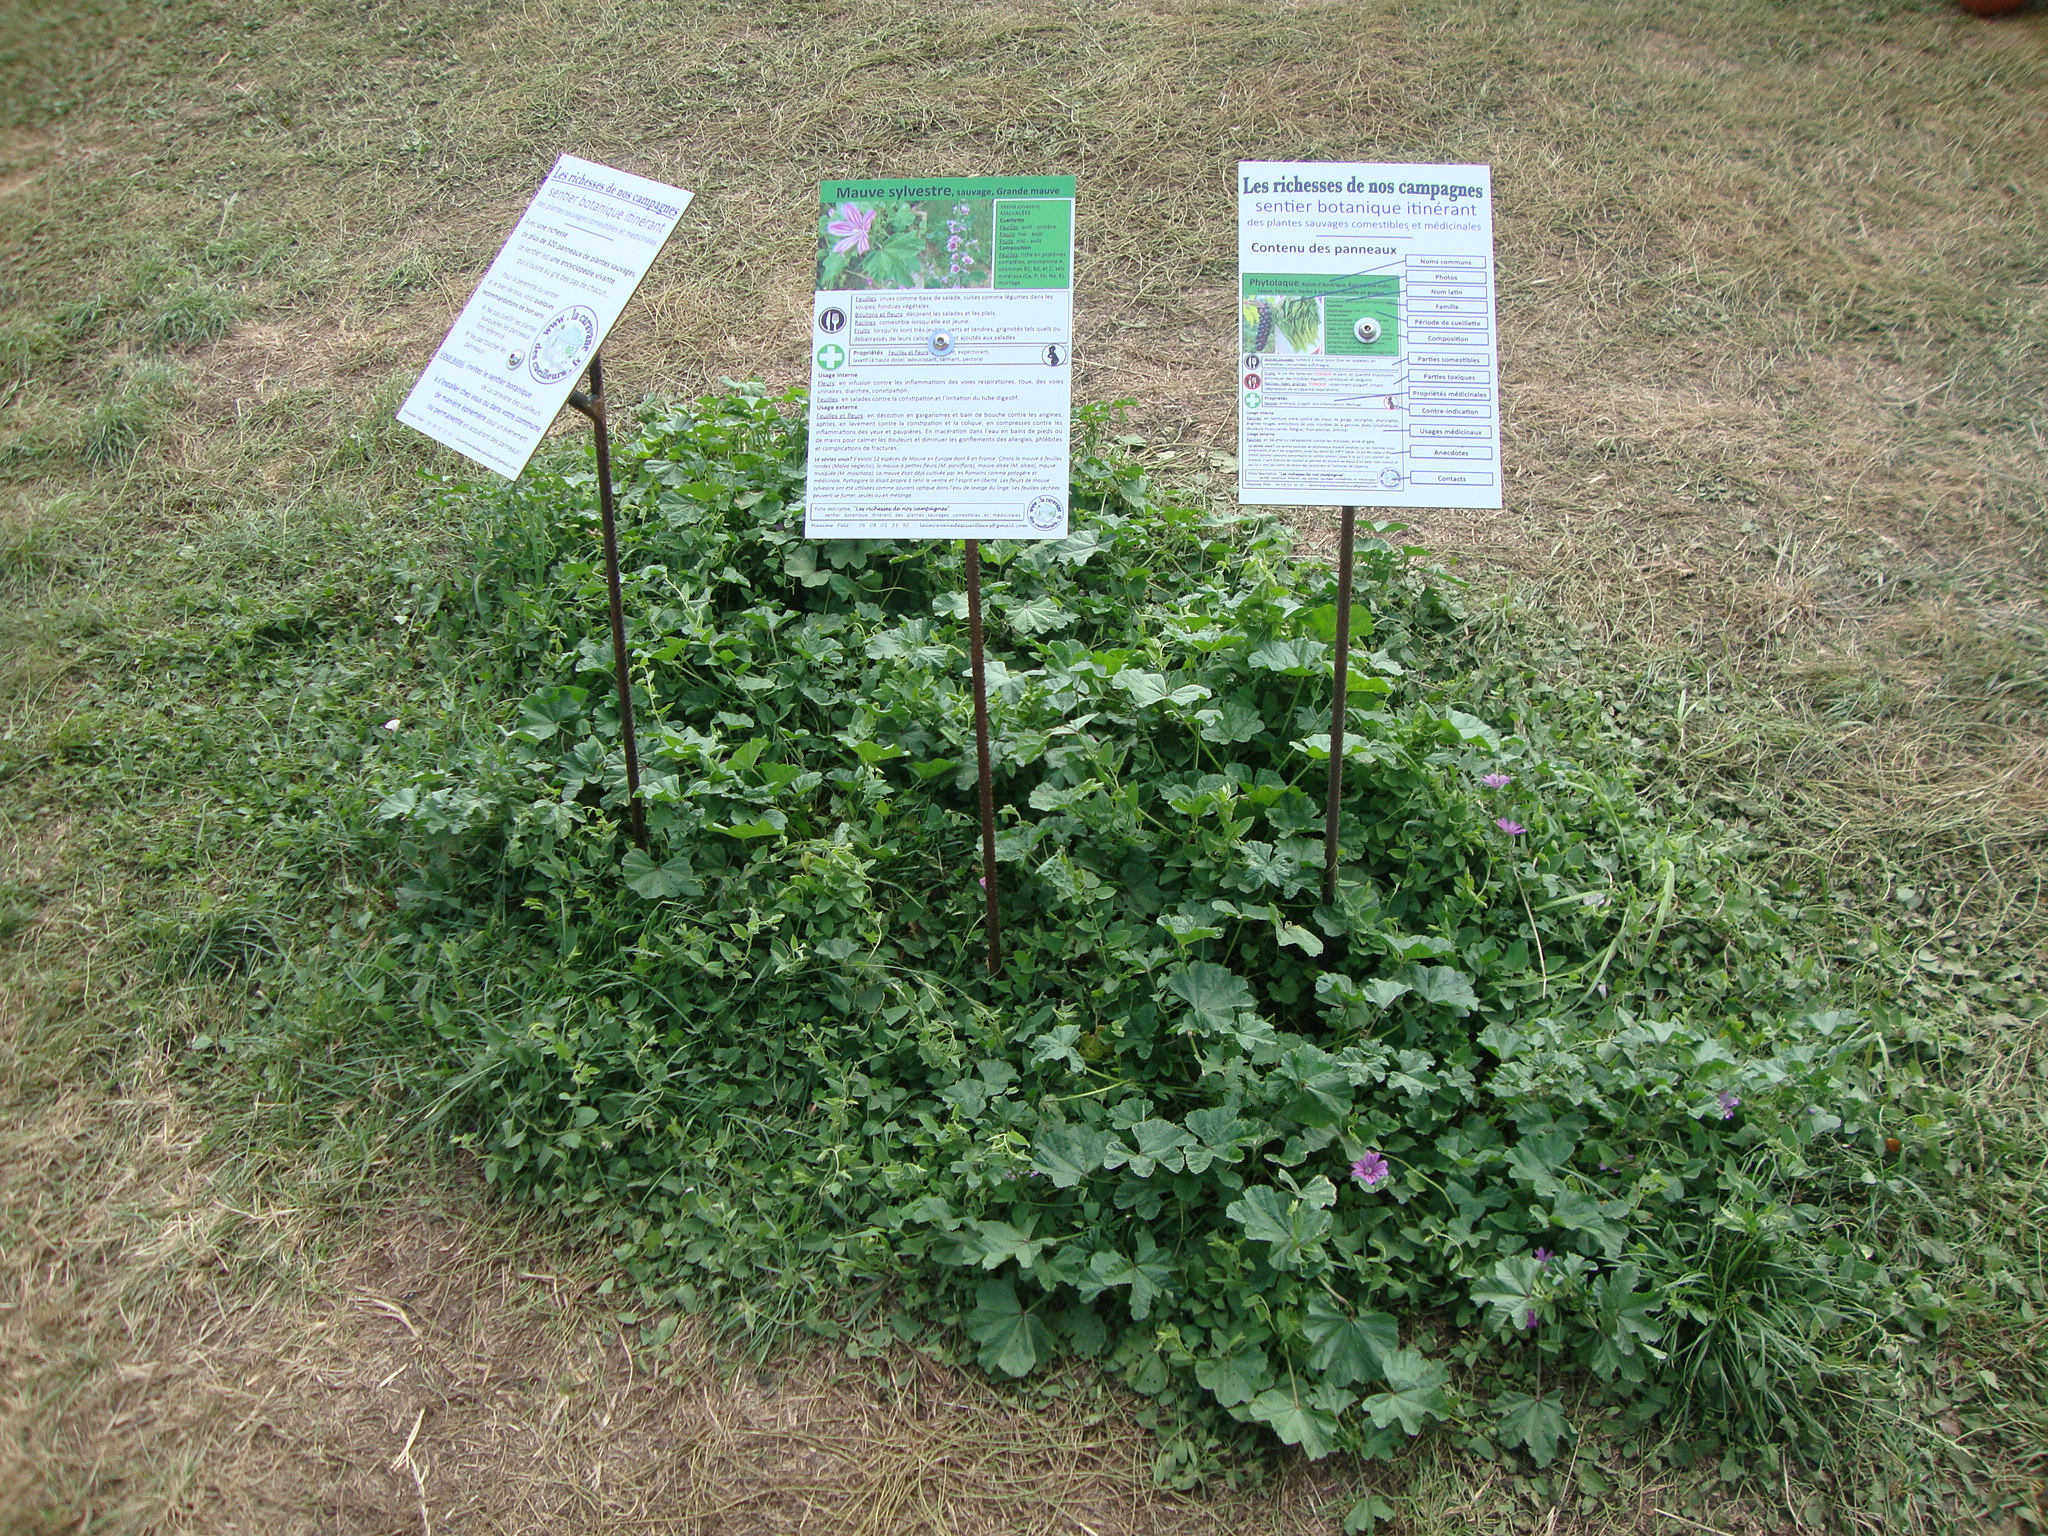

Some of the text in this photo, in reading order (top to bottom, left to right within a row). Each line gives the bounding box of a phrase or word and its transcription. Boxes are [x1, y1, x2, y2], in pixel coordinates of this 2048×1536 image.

[553, 166, 568, 180] Les
[567, 172, 605, 190] richesses
[616, 189, 632, 199] nos
[630, 194, 679, 218] campagnes
[836, 186, 884, 198] Mauve
[888, 184, 954, 200] sylvestre,
[956, 188, 994, 197] sauvage,
[1243, 174, 1483, 202] Les richesses de nos campagnes
[547, 187, 665, 233] sentier botanique itinérant
[1255, 199, 1476, 216] sentier botanique itinérant
[1247, 217, 1263, 226] des
[1266, 218, 1302, 228] plantes
[1305, 219, 1348, 229] sauvages
[1351, 219, 1409, 230] comestibles
[1424, 220, 1481, 230] médicinales
[1251, 242, 1396, 256] Contenu des panneaux
[579, 314, 594, 352] caravane
[1427, 335, 1468, 343] Composition
[532, 342, 542, 360] des
[532, 362, 566, 380] cueilleurs
